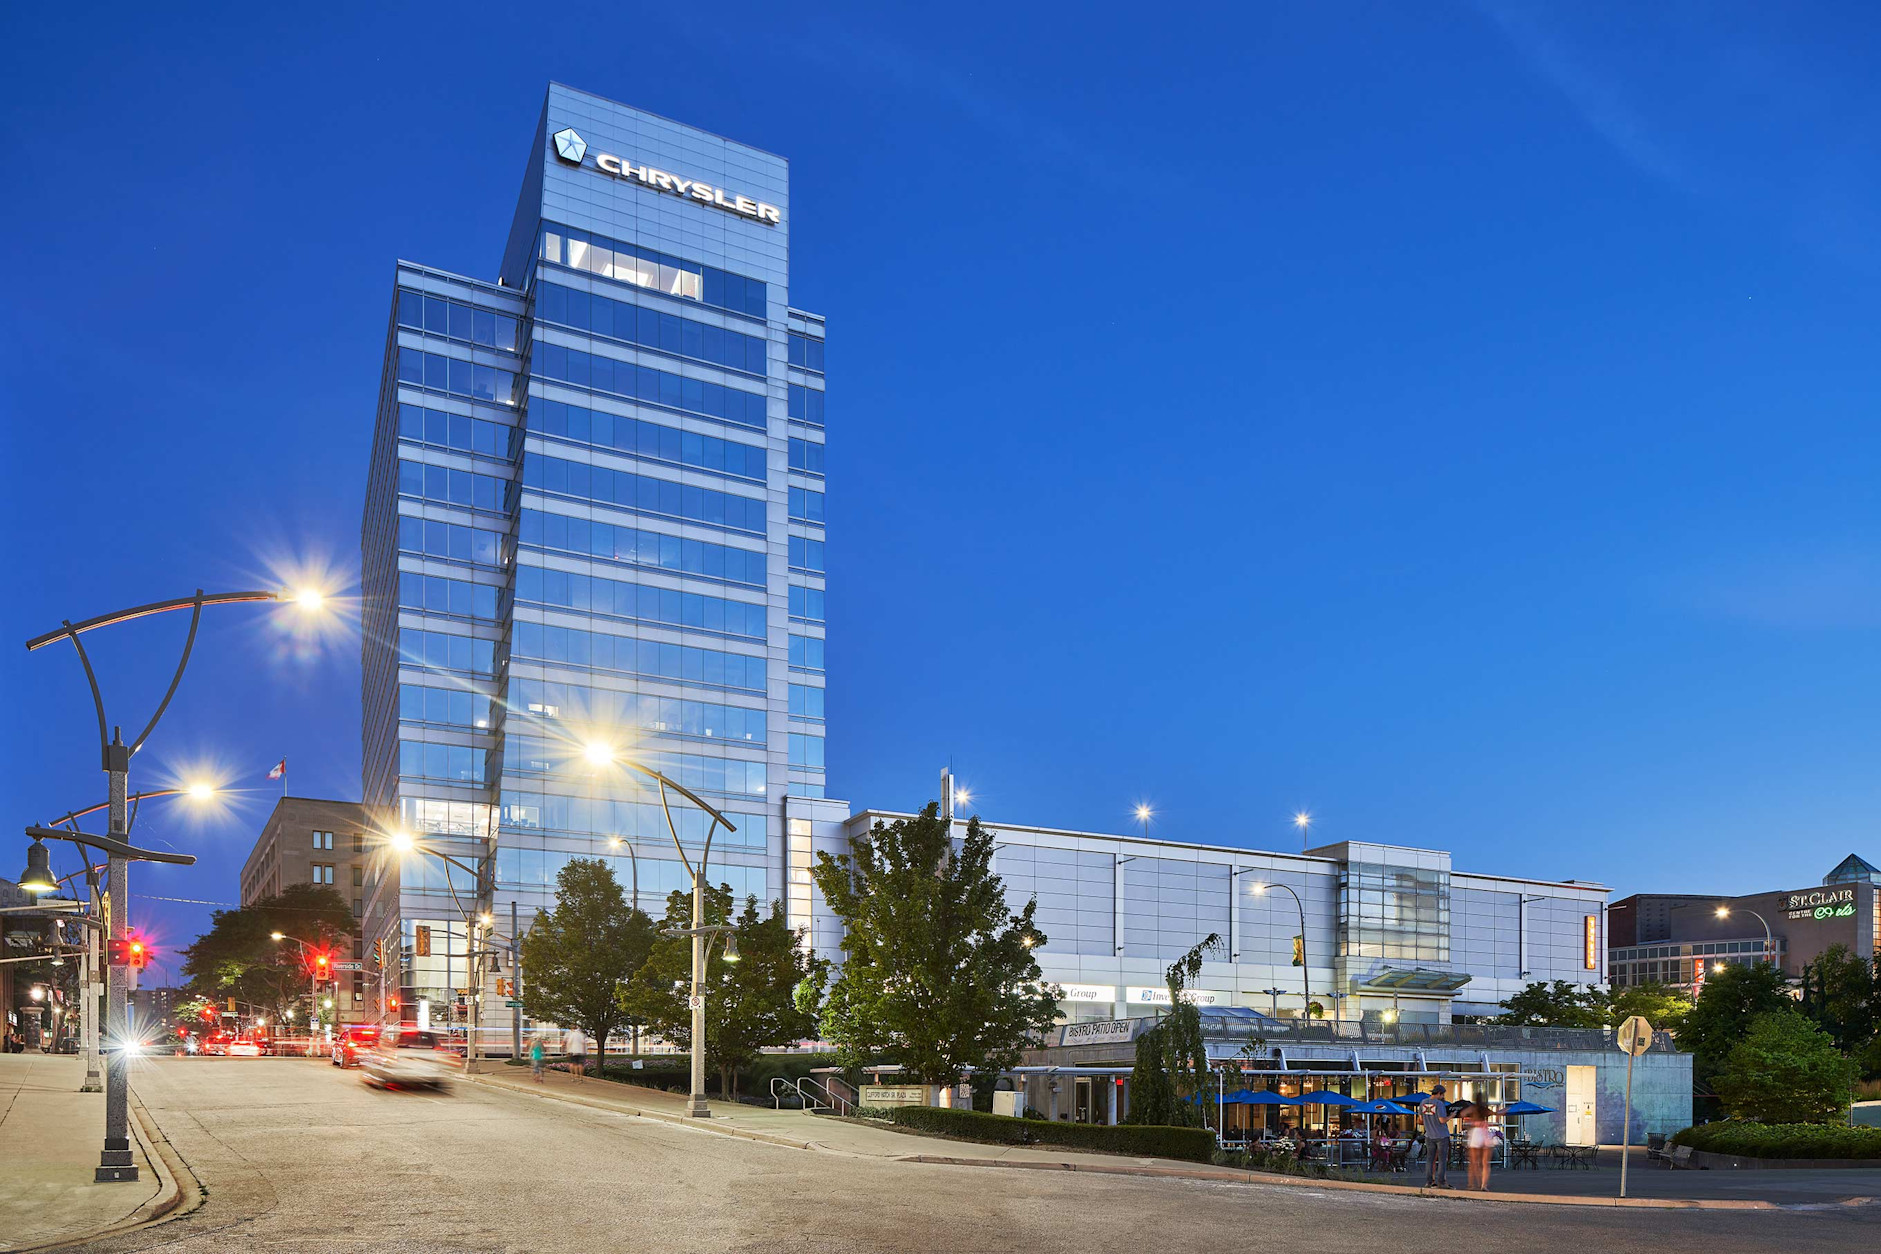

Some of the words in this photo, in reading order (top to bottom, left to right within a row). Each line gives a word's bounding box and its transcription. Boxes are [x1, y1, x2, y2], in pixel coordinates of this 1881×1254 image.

[596, 154, 780, 223] CHRYSLER
[1809, 889, 1854, 906] CLAIR
[1070, 988, 1097, 1000] Group
[1068, 1024, 1091, 1037] BISTRO
[1091, 1022, 1111, 1035] PATIO
[1111, 1021, 1130, 1034] OPEN
